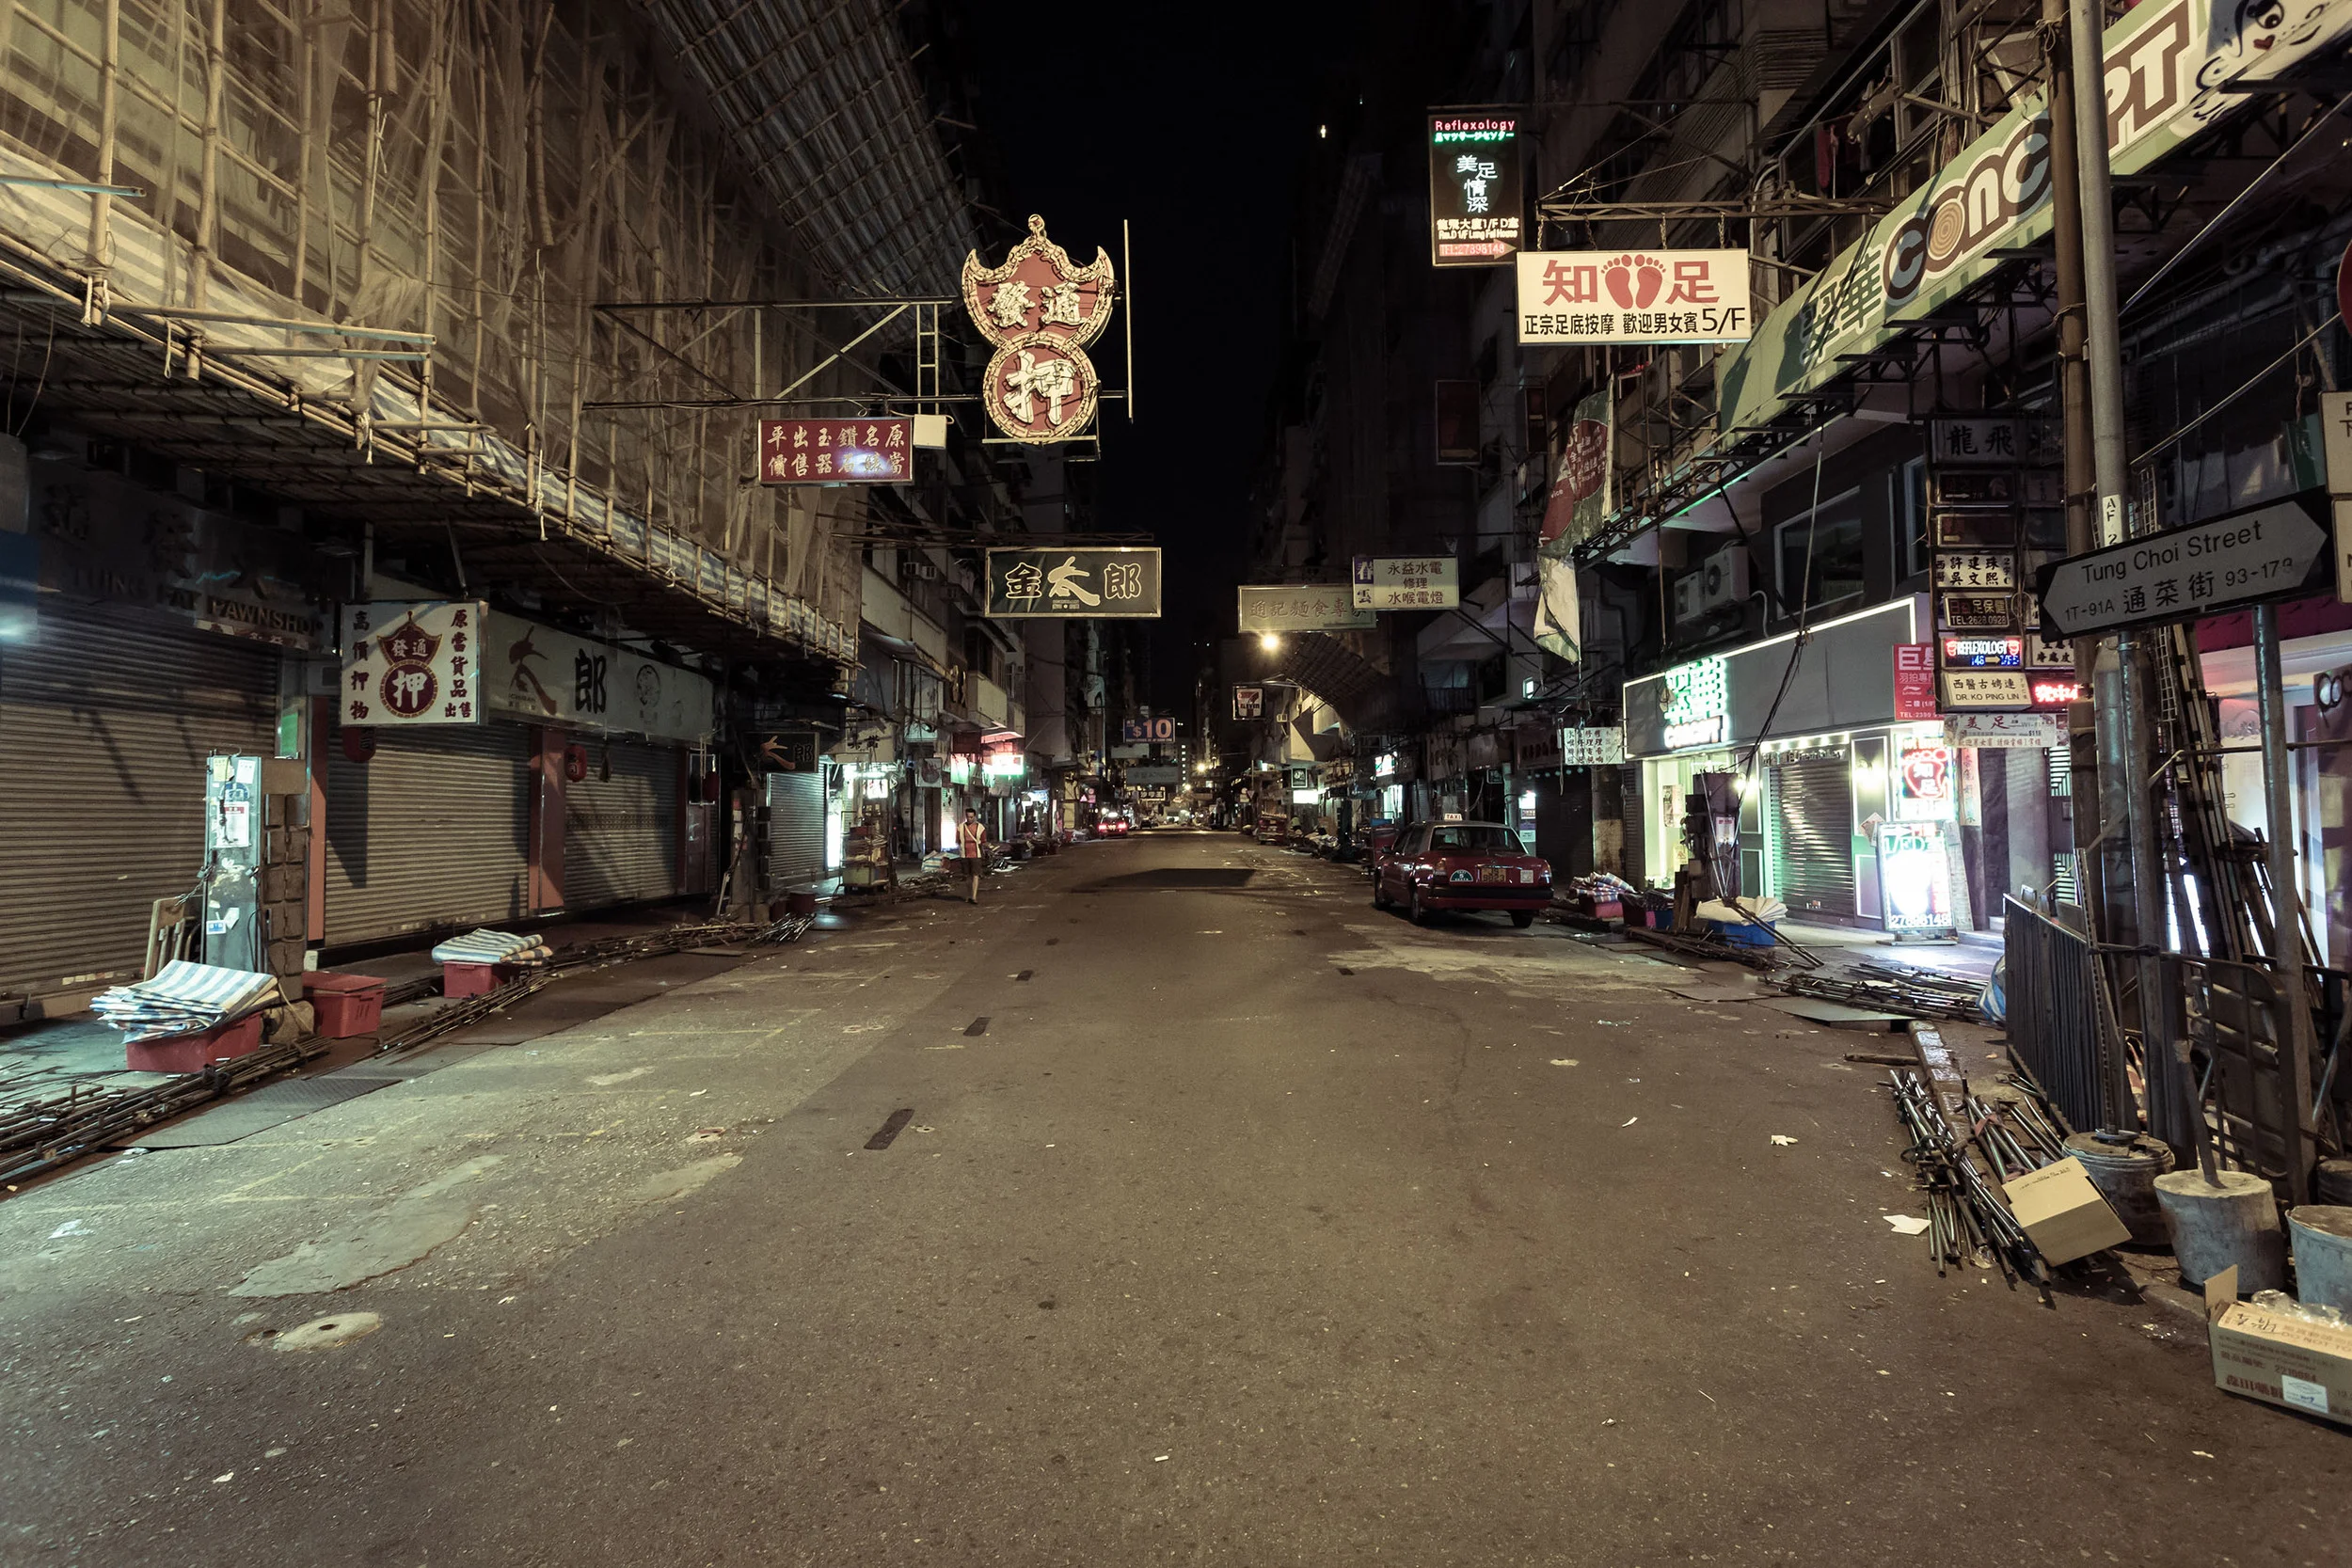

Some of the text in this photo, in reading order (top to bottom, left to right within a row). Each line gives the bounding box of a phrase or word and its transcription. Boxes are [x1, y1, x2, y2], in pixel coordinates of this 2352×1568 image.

[1436, 119, 1515, 131] Reflexology
[1884, 9, 2188, 306] CONCPT
[1524, 307, 1746, 335] 正宗足底按摩 歡迎男女賓 5/F
[1002, 349, 1078, 426] 押
[2082, 519, 2264, 584] Tung Choi Street
[1388, 561, 1442, 576] 永益水電
[1403, 577, 1427, 590] 修理
[2123, 571, 2216, 615] 通菜街
[1388, 591, 1444, 605] 水喉電燈
[1957, 641, 2007, 655] REFLEXOLOGY
[392, 670, 428, 709] 押
[2007, 692, 2020, 701] LIN
